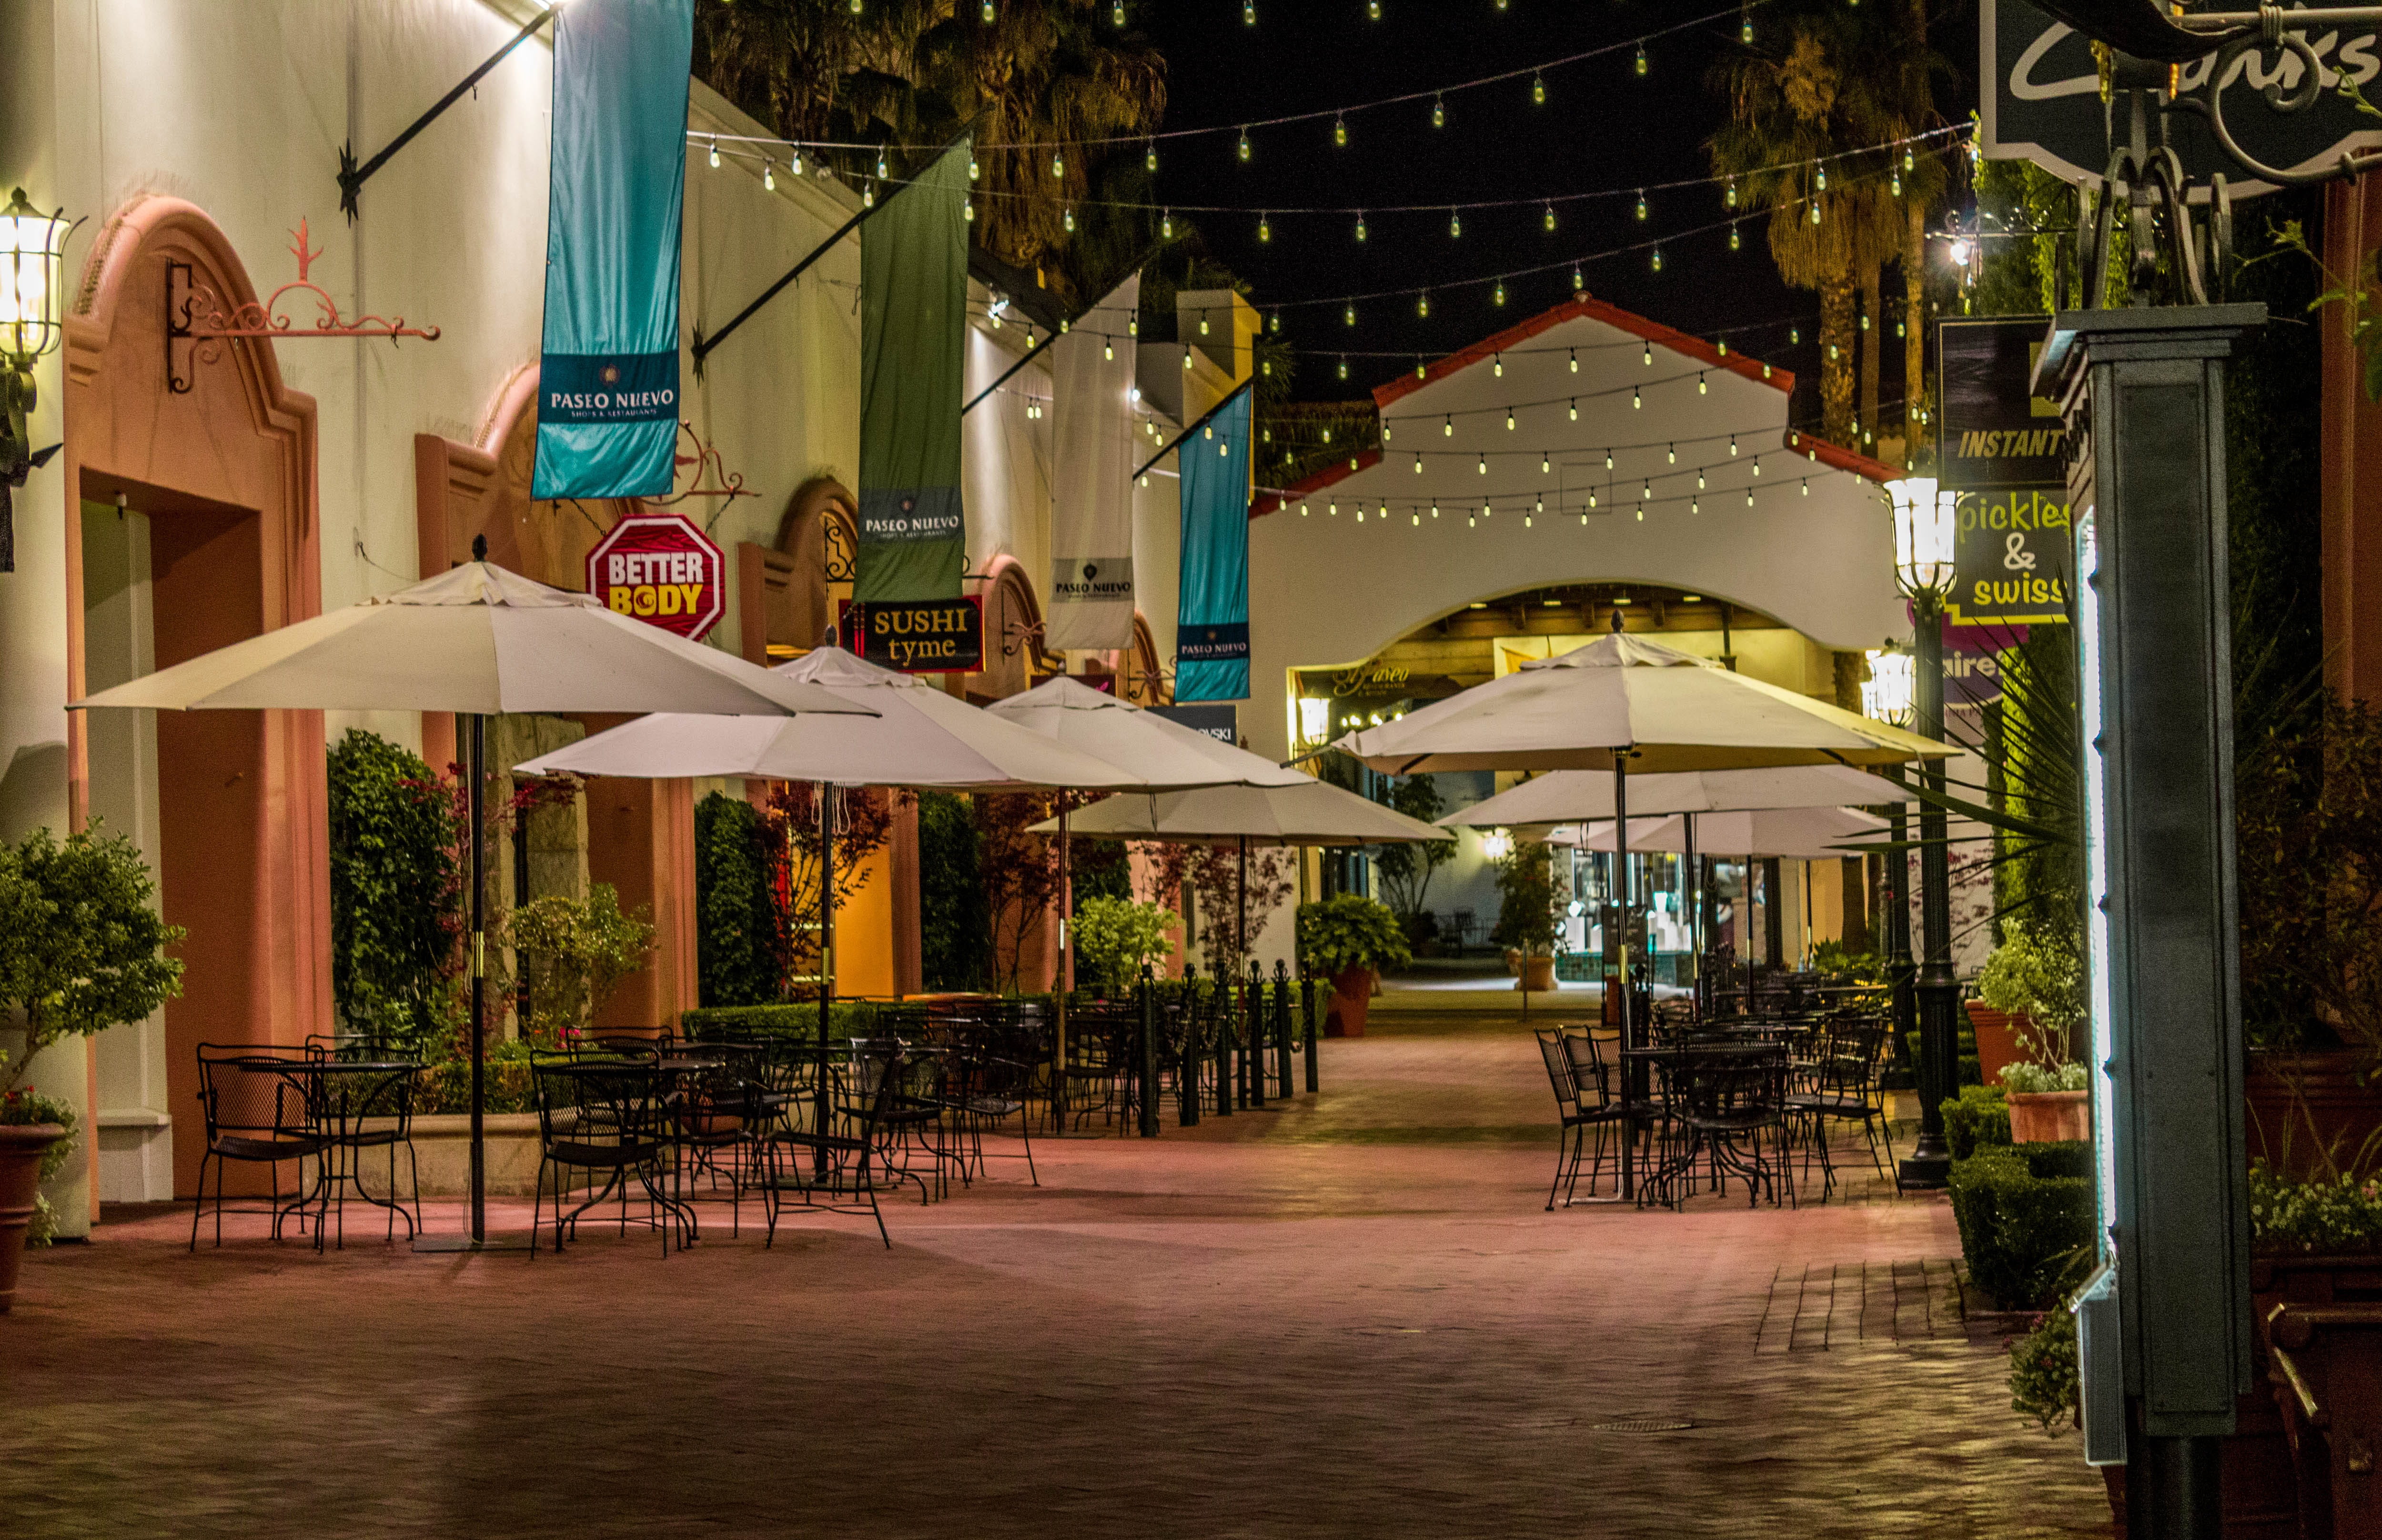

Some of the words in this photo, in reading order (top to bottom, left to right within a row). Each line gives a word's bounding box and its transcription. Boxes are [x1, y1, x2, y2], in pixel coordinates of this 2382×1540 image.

[551, 393, 609, 409] PASEO
[616, 389, 674, 408] NUEVO
[1958, 430, 2065, 457] INSTANT
[866, 519, 907, 532] PASEO
[912, 515, 959, 531] NUEVO
[2004, 532, 2036, 570] &
[609, 552, 704, 585] BETTER
[609, 584, 703, 616] BODY
[1056, 583, 1089, 593] PASEO
[1093, 581, 1130, 592] NUEVO
[1974, 572, 2068, 605] swiss
[875, 608, 968, 634] SUSHI
[888, 638, 956, 667] tyme
[1181, 644, 1212, 654] PASEO
[1215, 642, 1246, 652] NUEVO
